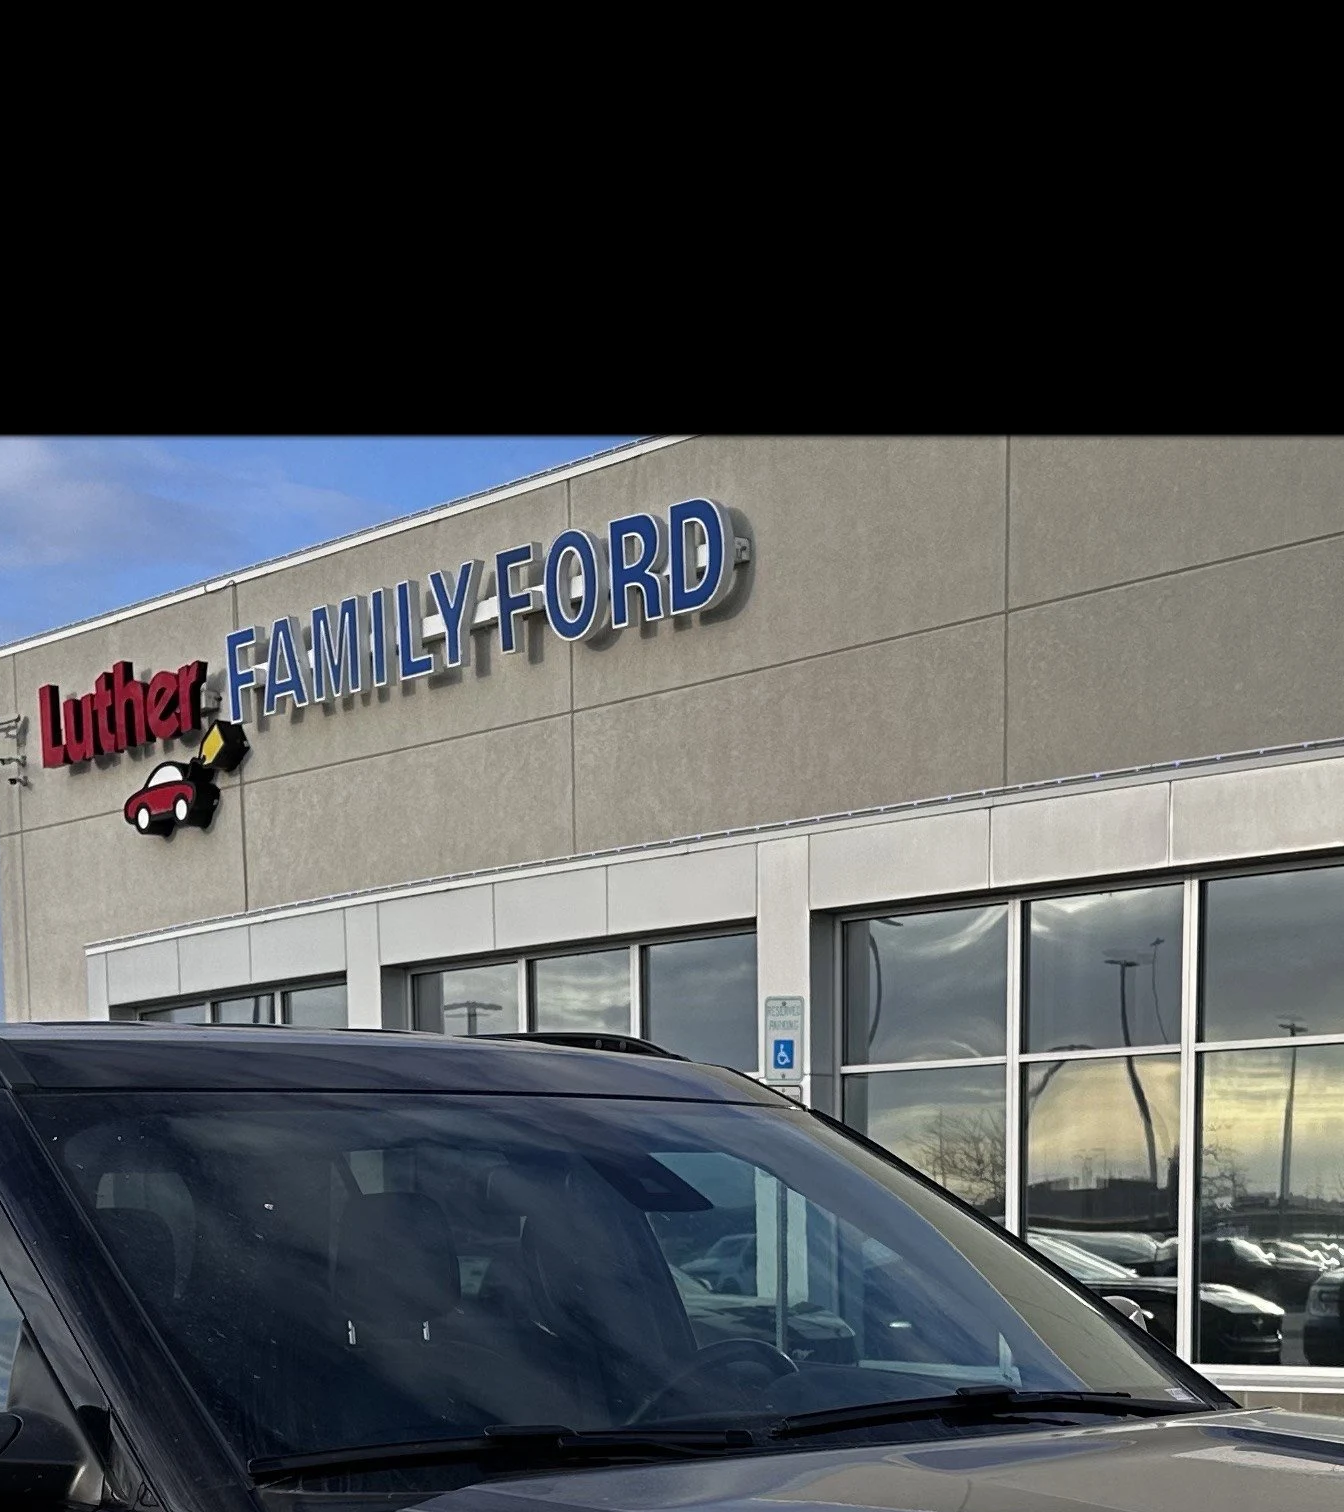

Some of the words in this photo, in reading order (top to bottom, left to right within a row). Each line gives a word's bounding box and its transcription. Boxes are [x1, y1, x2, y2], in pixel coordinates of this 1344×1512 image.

[227, 559, 483, 725] FAMILY
[495, 497, 734, 654] FORD
[39, 660, 207, 769] Luther
